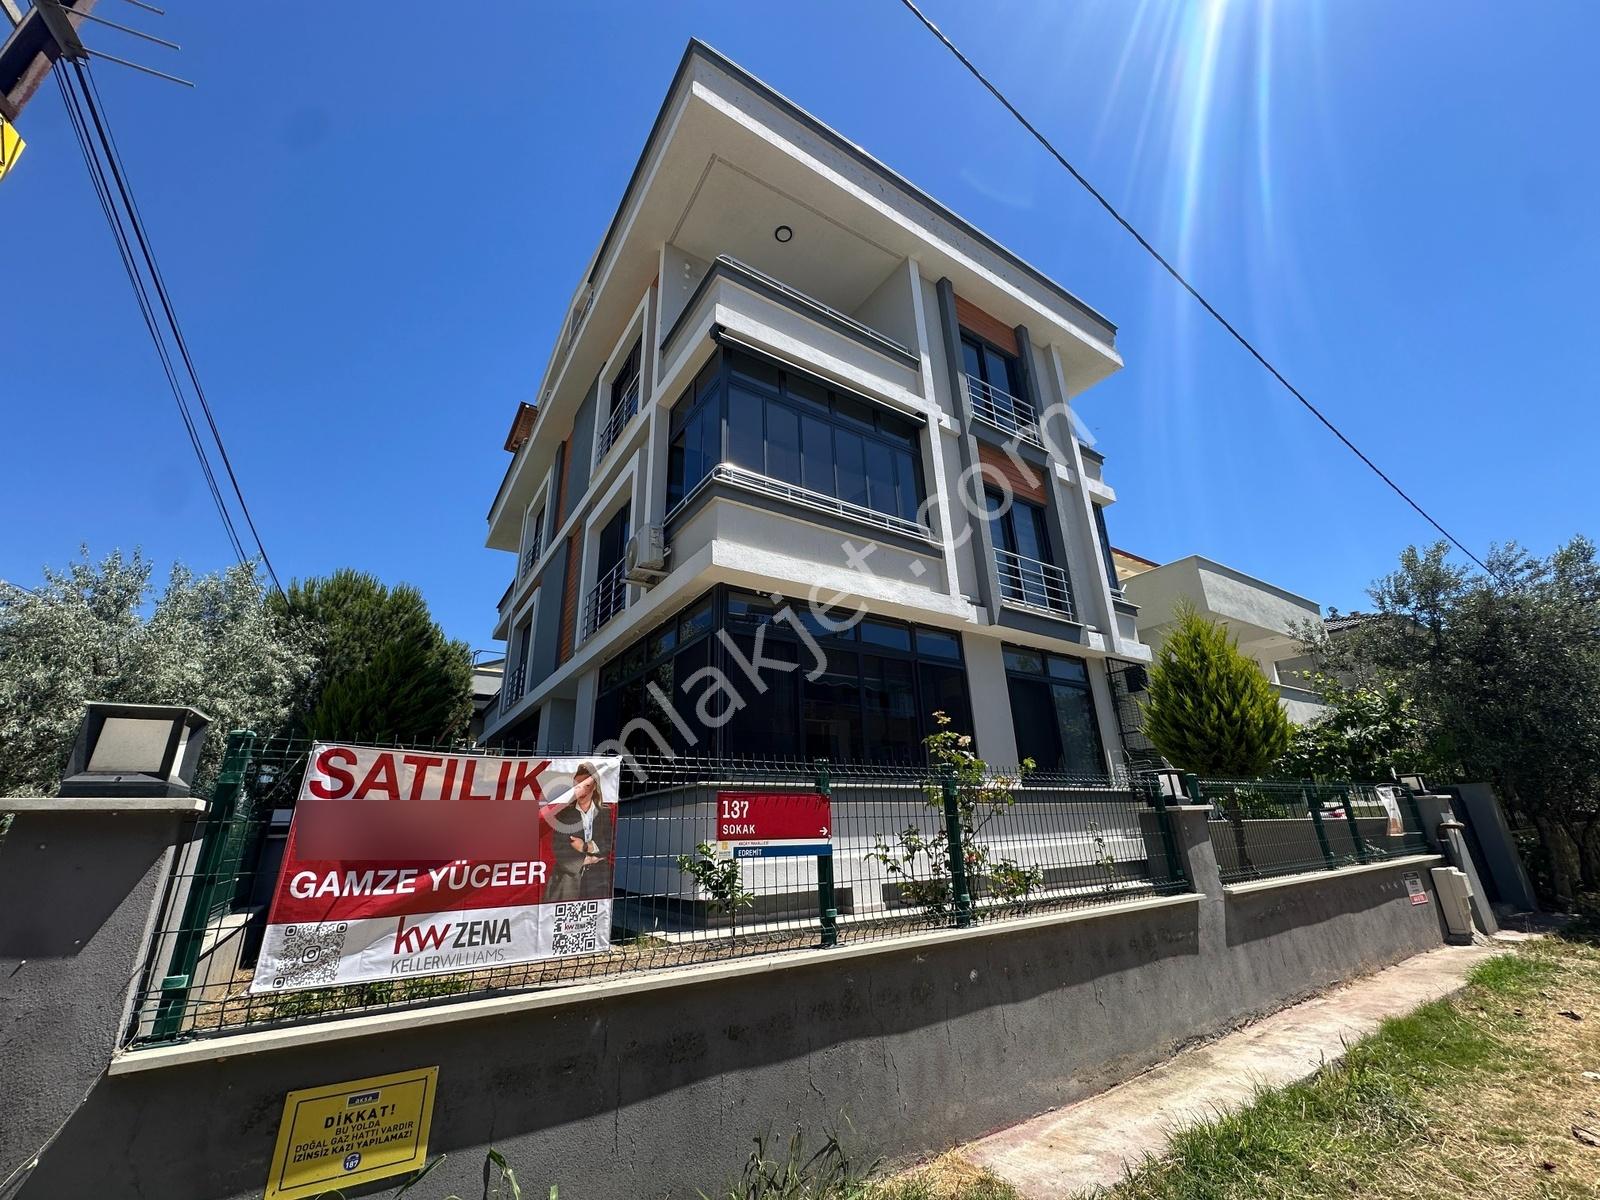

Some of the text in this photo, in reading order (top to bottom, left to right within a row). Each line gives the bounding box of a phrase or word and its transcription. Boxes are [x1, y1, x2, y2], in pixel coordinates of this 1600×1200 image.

[308, 747, 552, 800] SATILIK
[722, 800, 749, 818] 137
[722, 824, 755, 834] SOKAK
[290, 860, 547, 899] GAMZE YÜCEER
[452, 918, 511, 949] ZENA
[295, 1121, 414, 1153] DOĞAL GAZ HATTI VARDIR
[335, 1120, 380, 1136] BU YOLDA
[331, 1142, 354, 1155] KAZI
